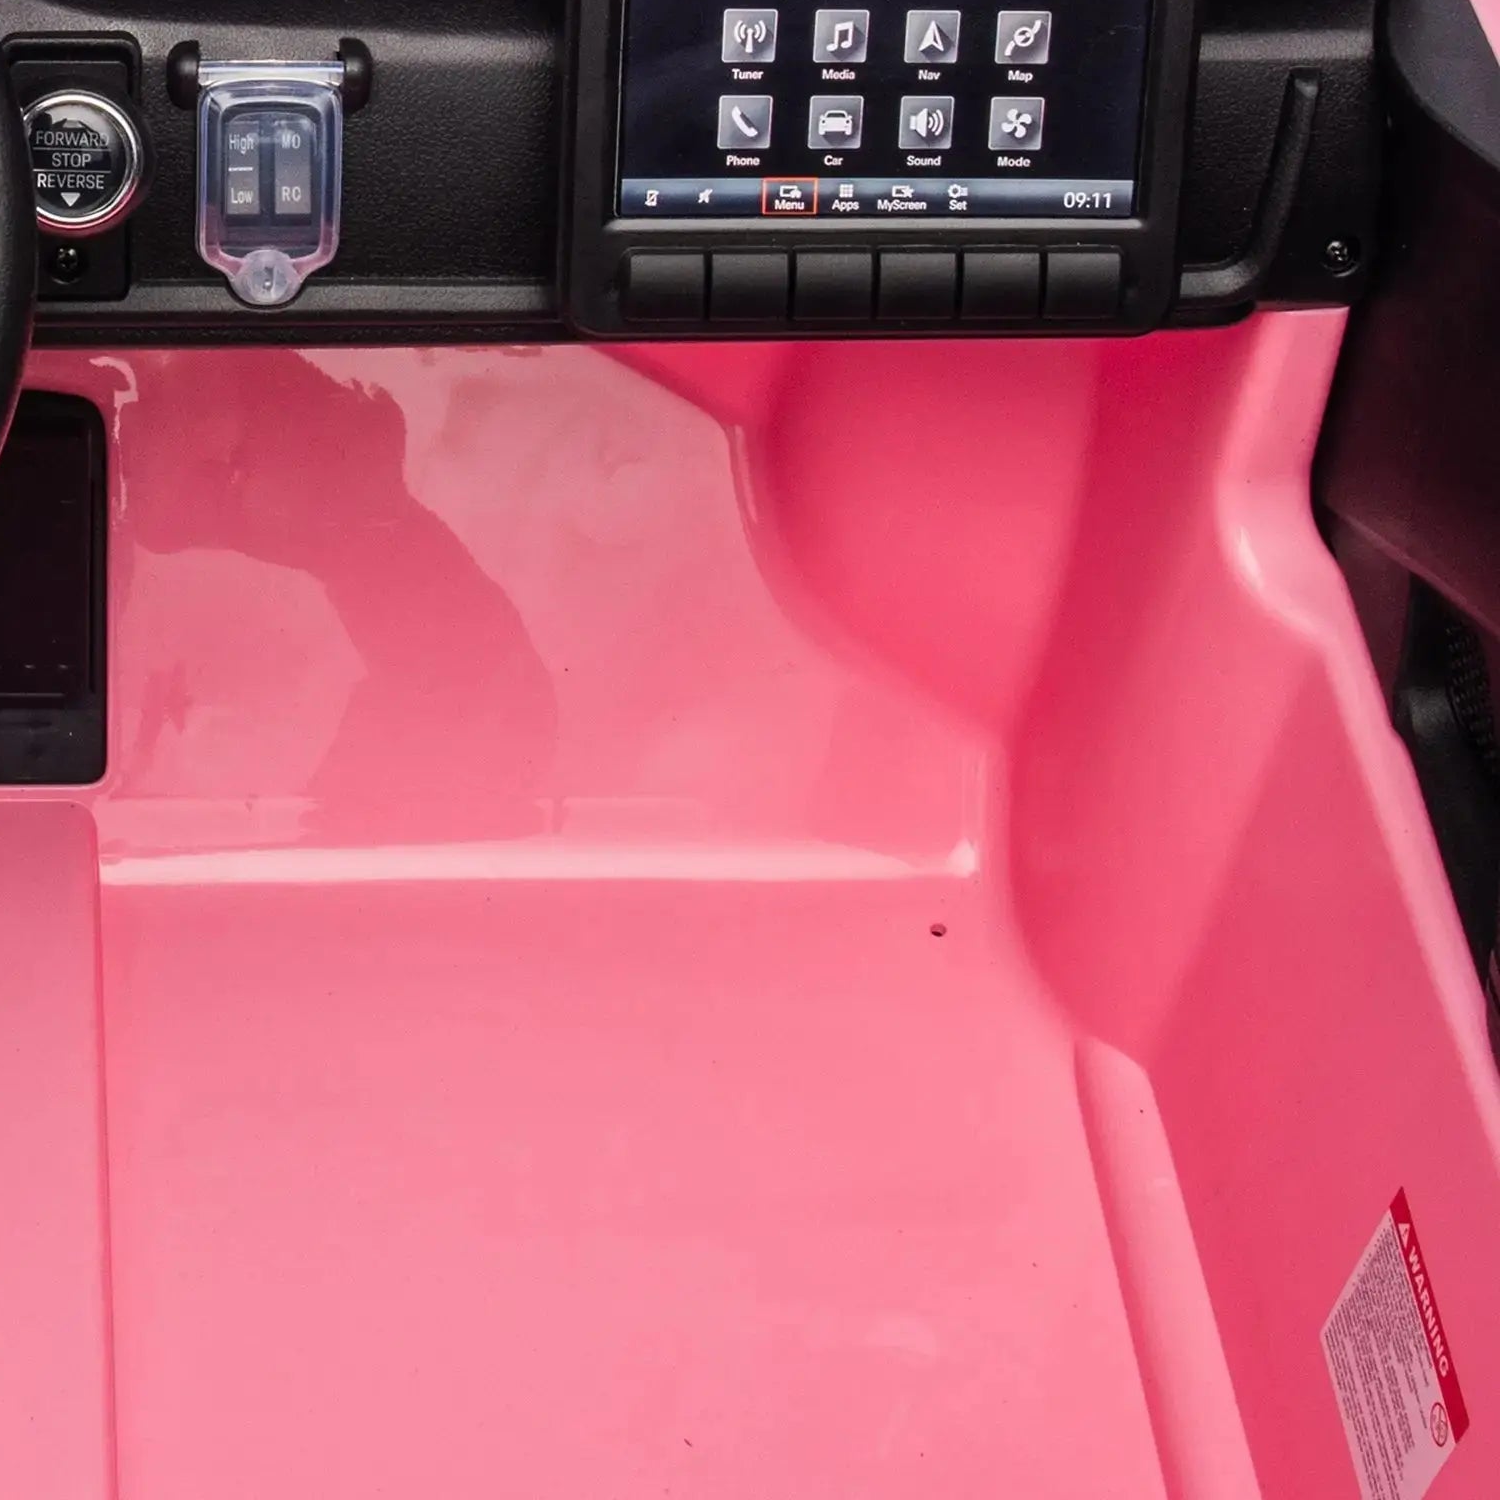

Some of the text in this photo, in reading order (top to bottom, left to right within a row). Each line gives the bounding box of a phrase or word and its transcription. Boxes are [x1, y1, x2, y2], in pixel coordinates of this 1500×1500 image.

[731, 68, 764, 80] Tuner
[821, 68, 856, 80] Media
[918, 69, 941, 81] Nav
[1007, 70, 1034, 83] Map
[35, 130, 110, 147] FORWARD
[228, 132, 254, 155] High
[51, 152, 92, 168] STOP
[726, 155, 760, 167] Phone
[823, 155, 844, 167] Car
[906, 155, 942, 167] Sound
[997, 156, 1031, 168] Mode
[37, 172, 105, 190] REVERSE
[230, 187, 253, 204] Low
[281, 186, 301, 202] RC
[1063, 191, 1112, 209] 09:11
[774, 199, 805, 211] Menu
[832, 199, 860, 212] Apps
[876, 199, 928, 212] MyScreen
[949, 199, 968, 211] Set
[1408, 1245, 1449, 1378] WARNING
